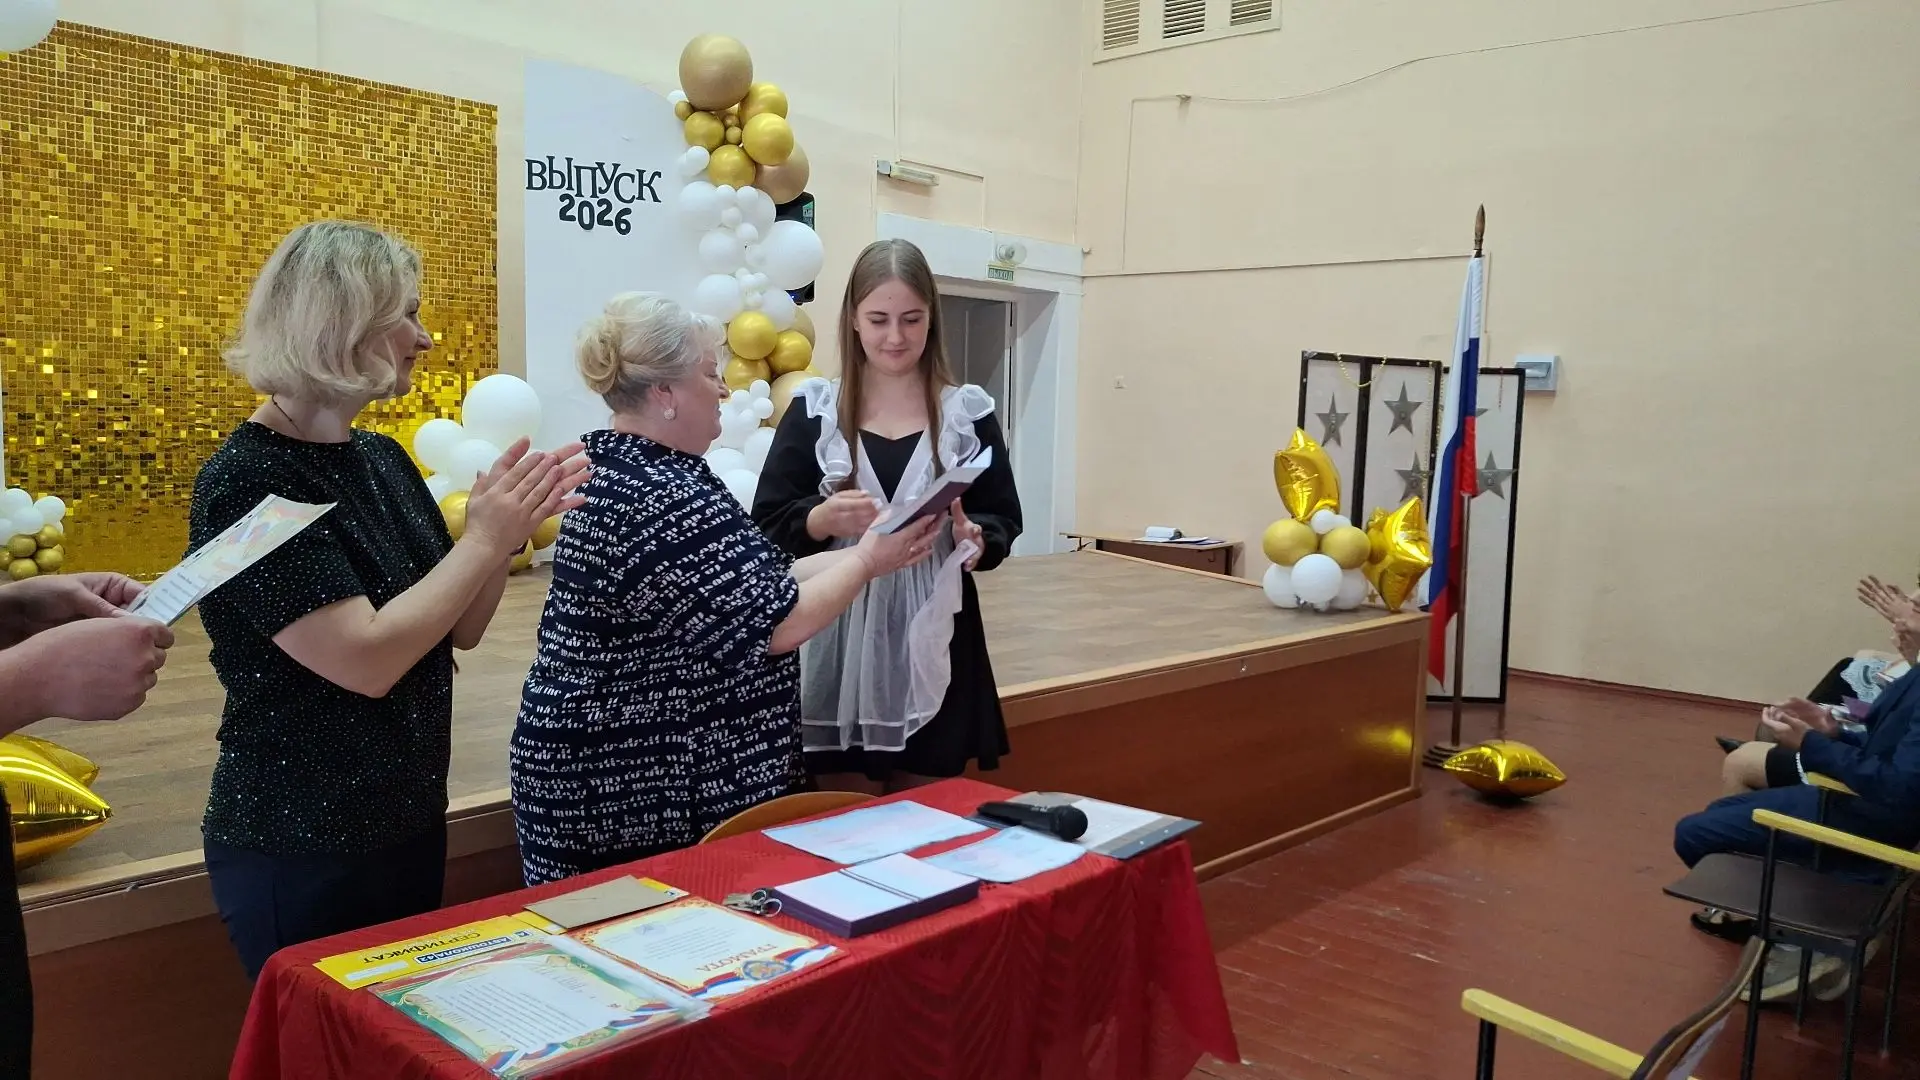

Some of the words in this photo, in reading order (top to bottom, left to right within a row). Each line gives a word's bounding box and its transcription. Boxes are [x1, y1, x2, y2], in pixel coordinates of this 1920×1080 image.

[525, 156, 662, 203] ВЫПУСК
[559, 193, 632, 235] 2026
[989, 268, 1013, 281] ВЫХОД
[363, 932, 481, 964] СЕРТИФИКАТ
[417, 953, 436, 963] 42
[437, 937, 510, 959] АВТОШКОЛА
[696, 944, 778, 972] ГРАМОТА
